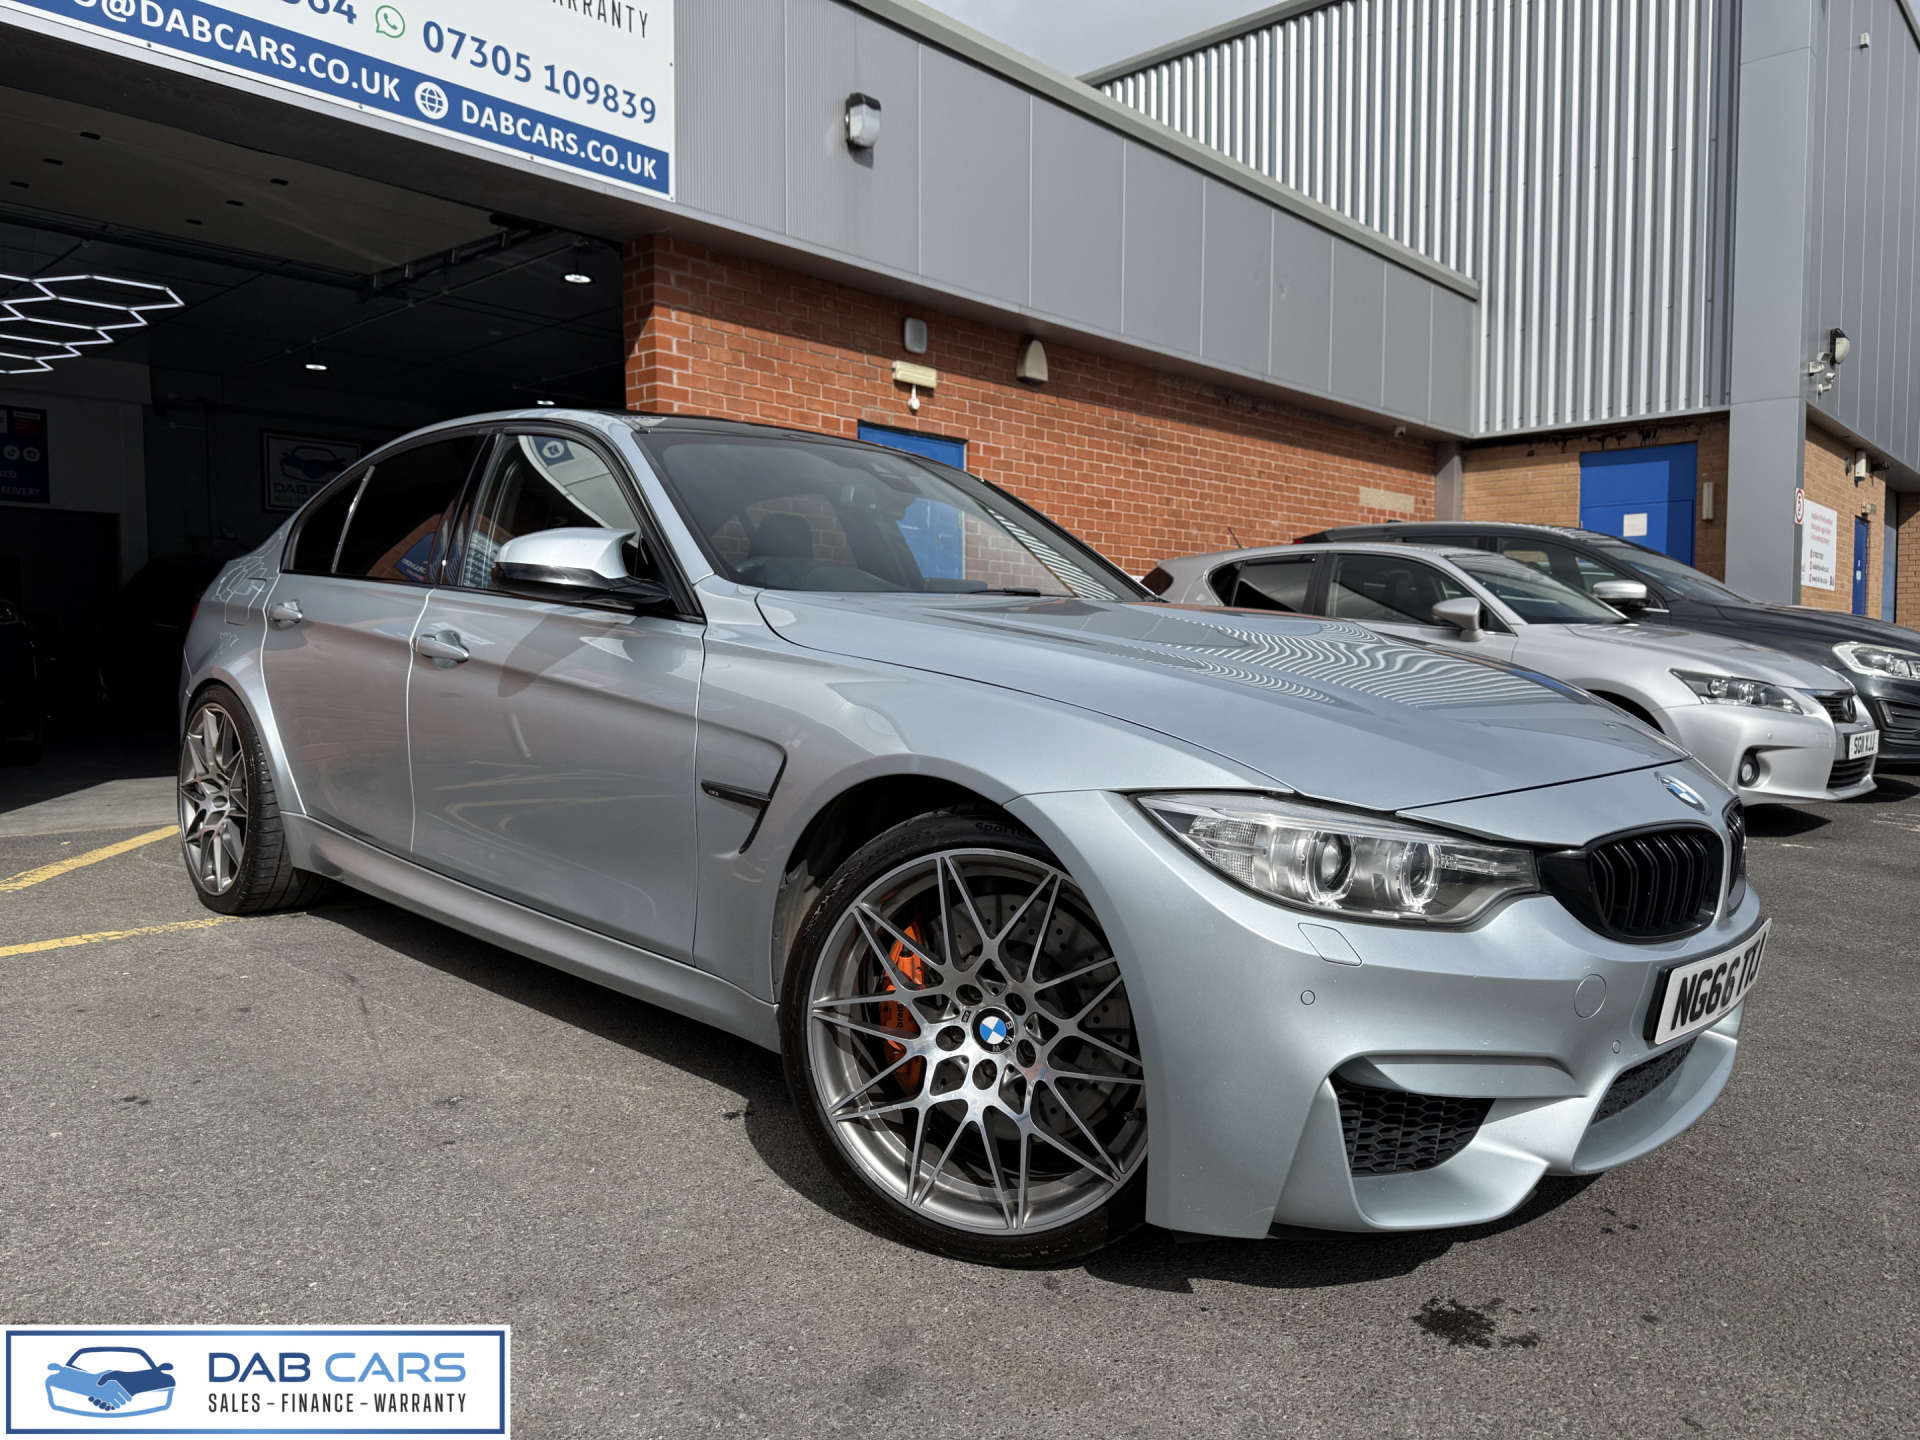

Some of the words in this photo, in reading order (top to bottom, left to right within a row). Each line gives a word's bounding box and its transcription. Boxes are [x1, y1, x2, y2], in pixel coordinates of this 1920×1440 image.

[73, 0, 400, 102] @DABCARS.CO.UK
[552, 0, 648, 38] RANTY
[423, 20, 532, 83] 07305
[544, 64, 656, 124] 109839
[461, 99, 657, 180] DABCARS.CO.UK
[1671, 956, 1740, 1031] NG66
